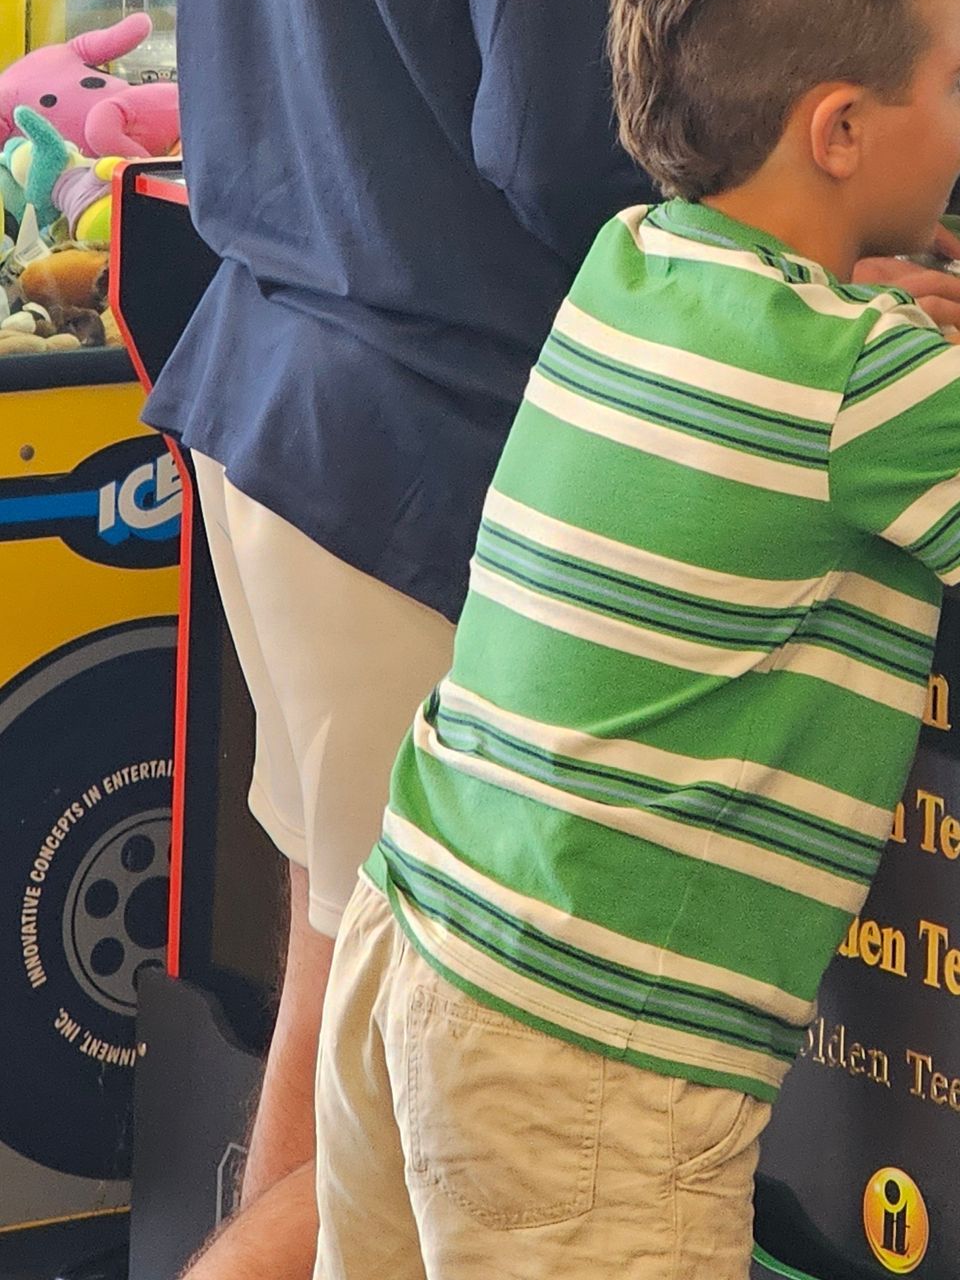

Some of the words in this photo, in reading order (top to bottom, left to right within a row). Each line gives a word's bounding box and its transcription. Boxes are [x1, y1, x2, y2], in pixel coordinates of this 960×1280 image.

[102, 758, 174, 795] ENTERTAI
[81, 783, 102, 809] IN
[29, 801, 85, 883] CONCEPTS
[21, 885, 48, 989] INNOVATIVE
[54, 1007, 82, 1043] INC.
[79, 1030, 137, 1068] INMENT,
